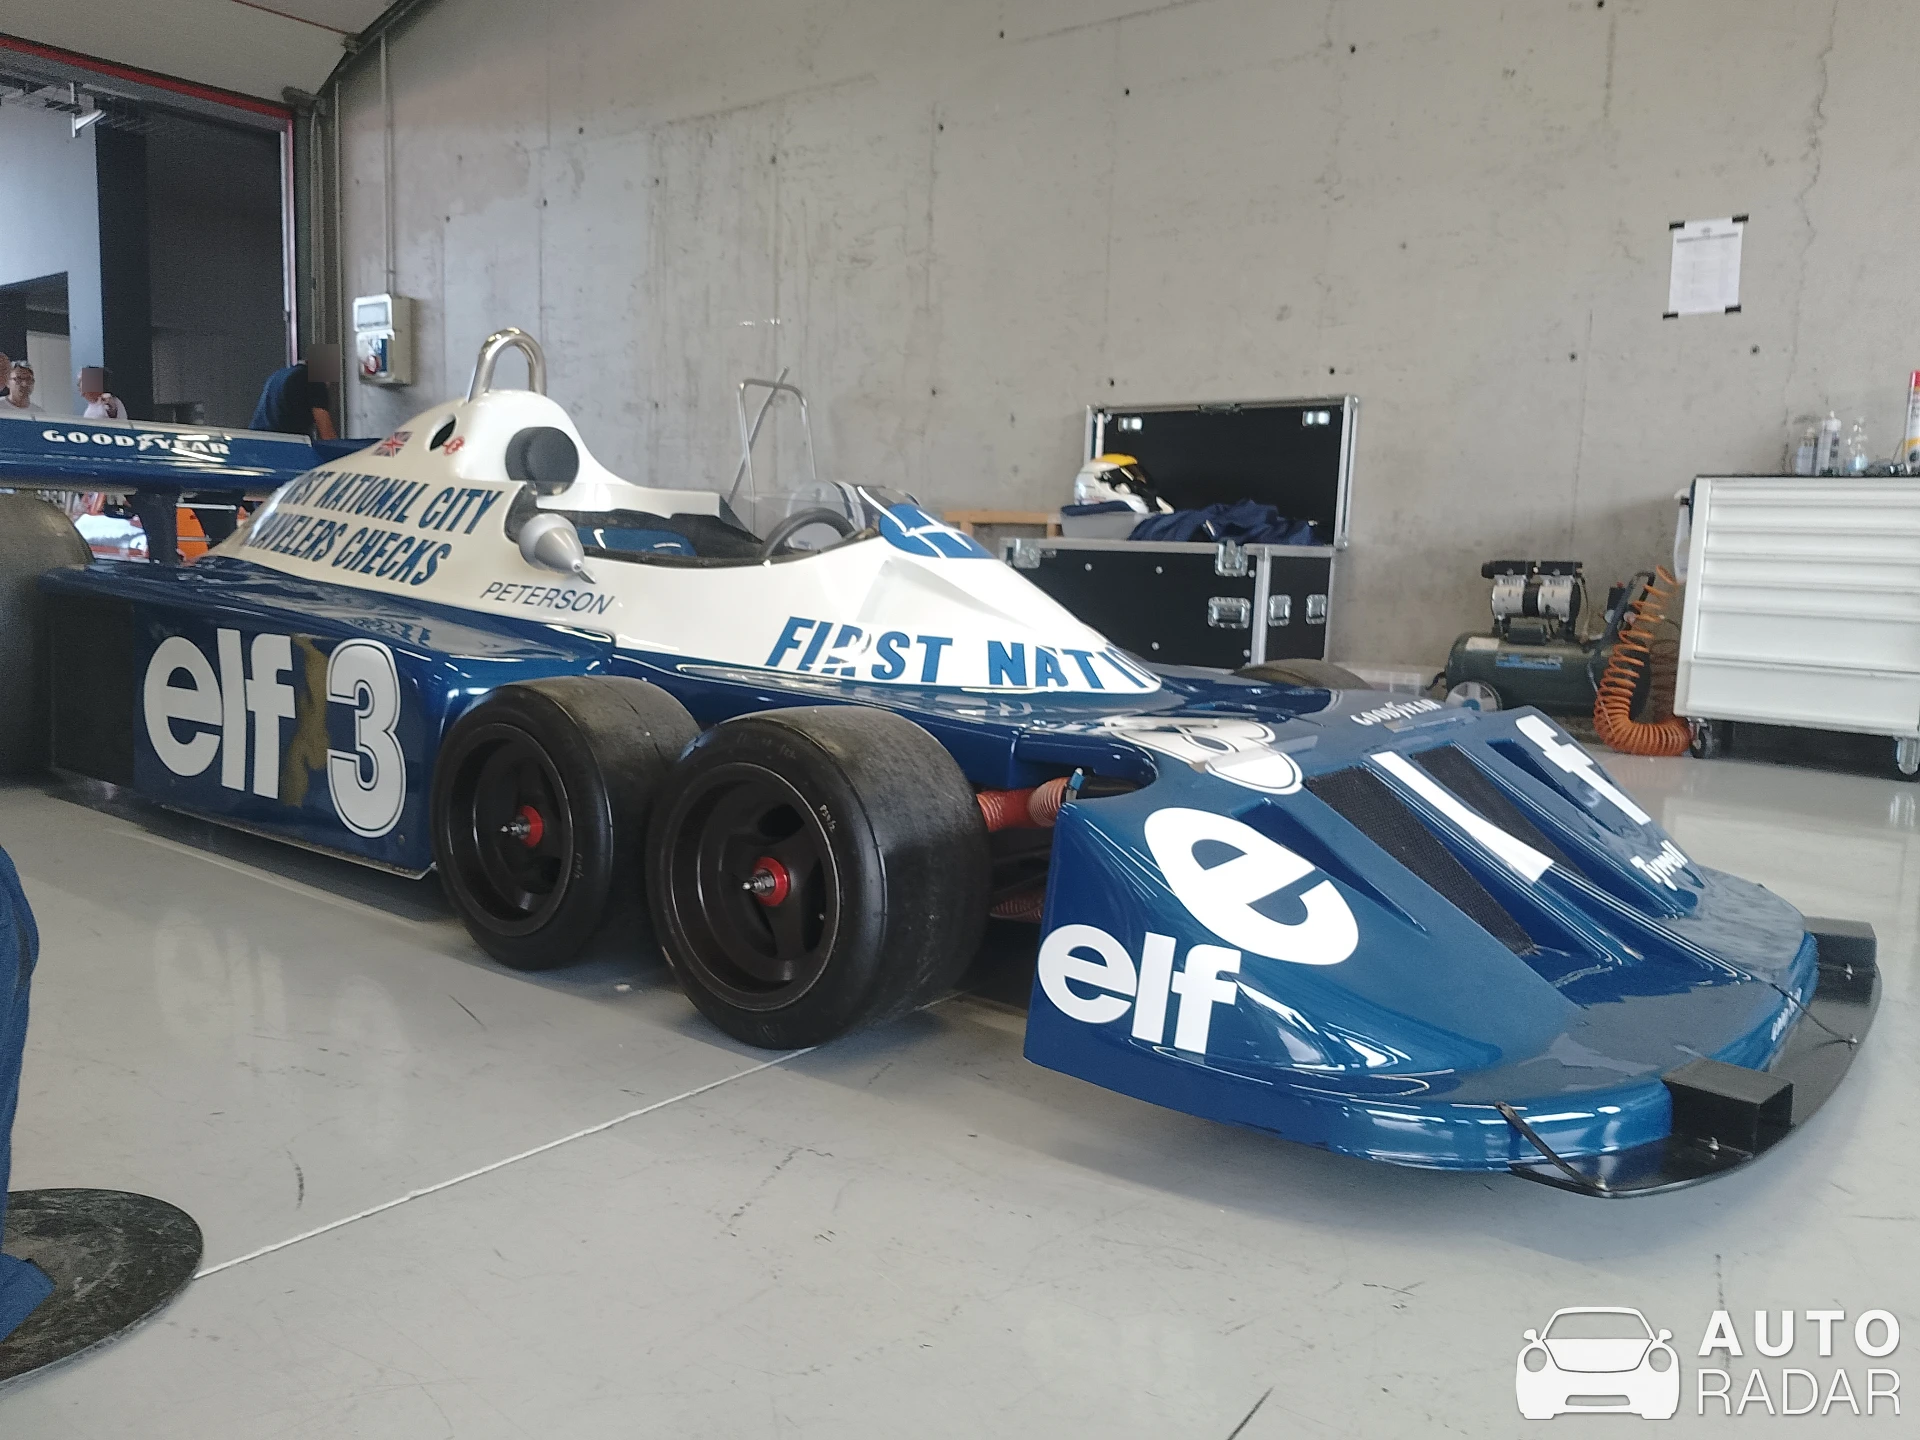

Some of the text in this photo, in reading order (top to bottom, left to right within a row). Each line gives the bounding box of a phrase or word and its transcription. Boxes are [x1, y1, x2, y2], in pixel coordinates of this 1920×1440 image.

[314, 471, 430, 524] NATIONAL
[418, 486, 504, 535] CITY
[331, 527, 452, 586] CHECKS
[480, 581, 615, 615] PETERSON
[764, 616, 953, 684] FIRST
[143, 628, 406, 838] elf 3
[1038, 924, 1241, 1054] elf
